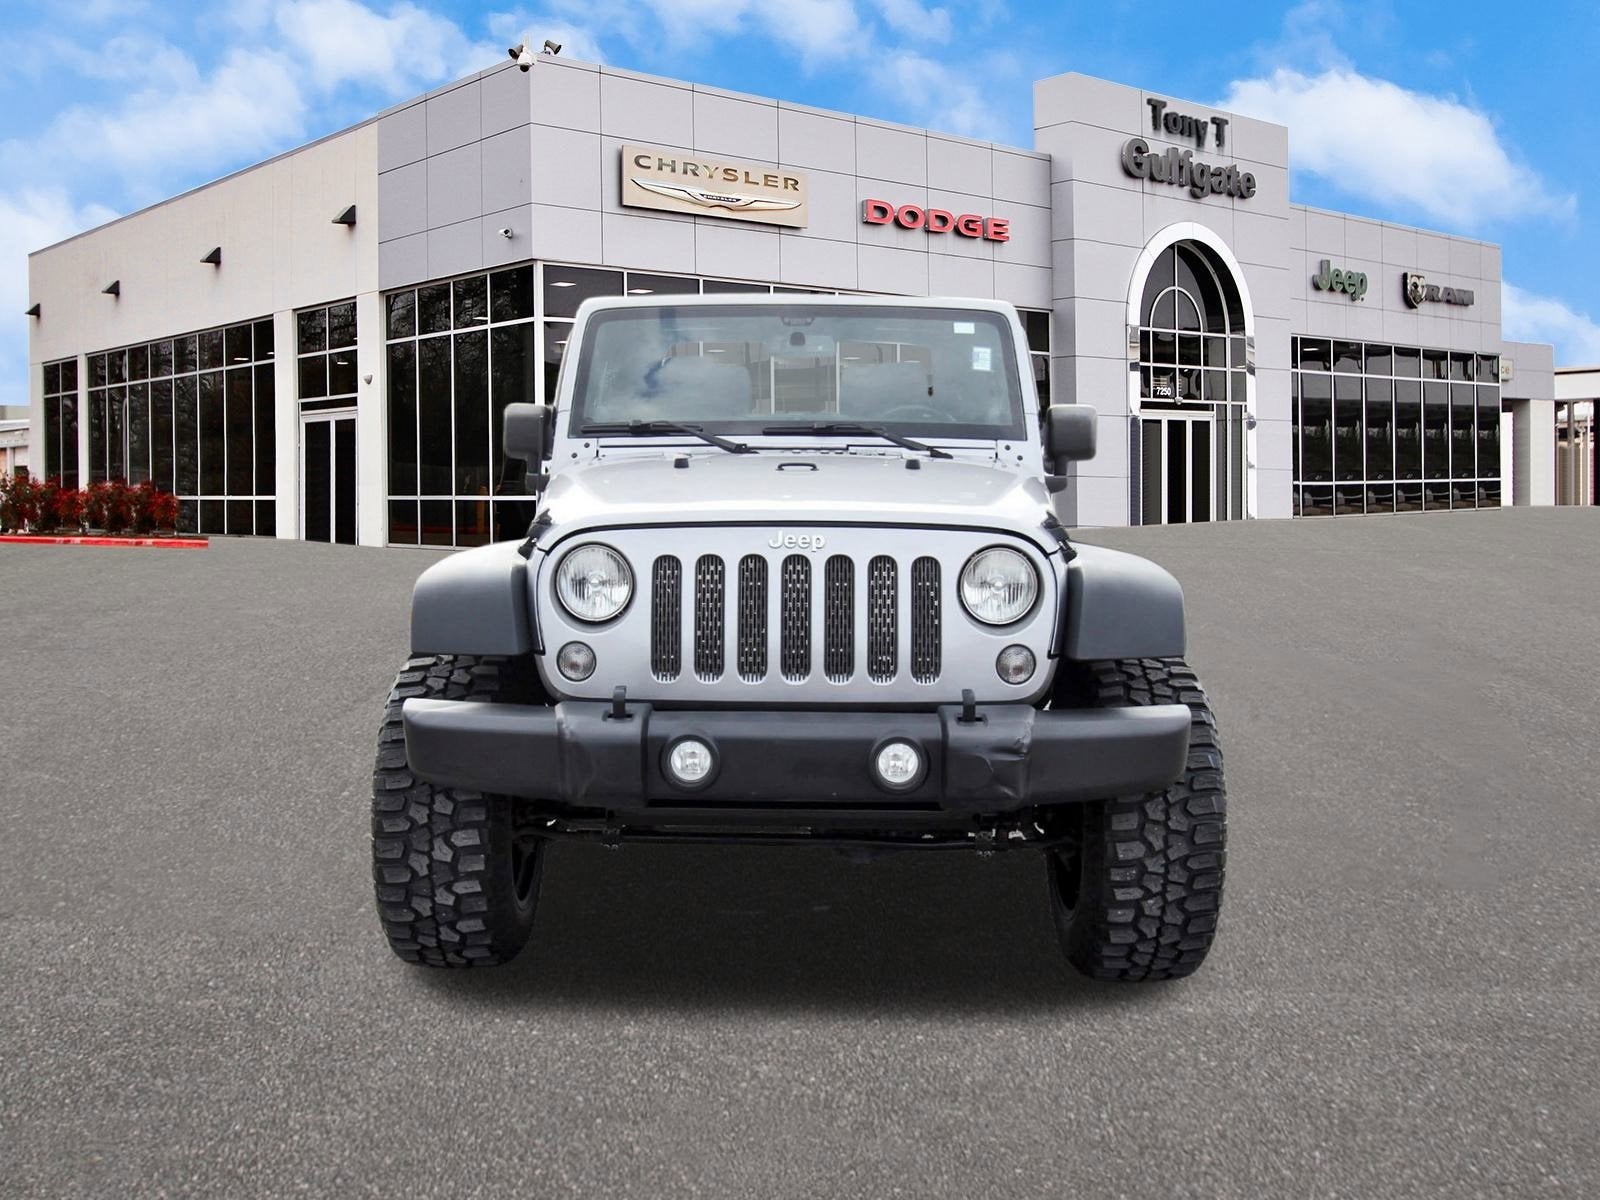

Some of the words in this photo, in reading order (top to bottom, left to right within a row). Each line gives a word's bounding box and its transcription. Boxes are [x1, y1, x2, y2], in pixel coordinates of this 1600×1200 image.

[1147, 98, 1208, 147] Tony
[1210, 117, 1229, 147] T
[634, 154, 799, 191] CHRYSLER
[1122, 137, 1256, 199] Gulfgate
[862, 199, 1010, 242] DODGE
[1312, 259, 1368, 301] Jeep
[1424, 284, 1474, 306] RAM
[1156, 386, 1172, 396] 7250
[768, 530, 825, 552] Jeep
